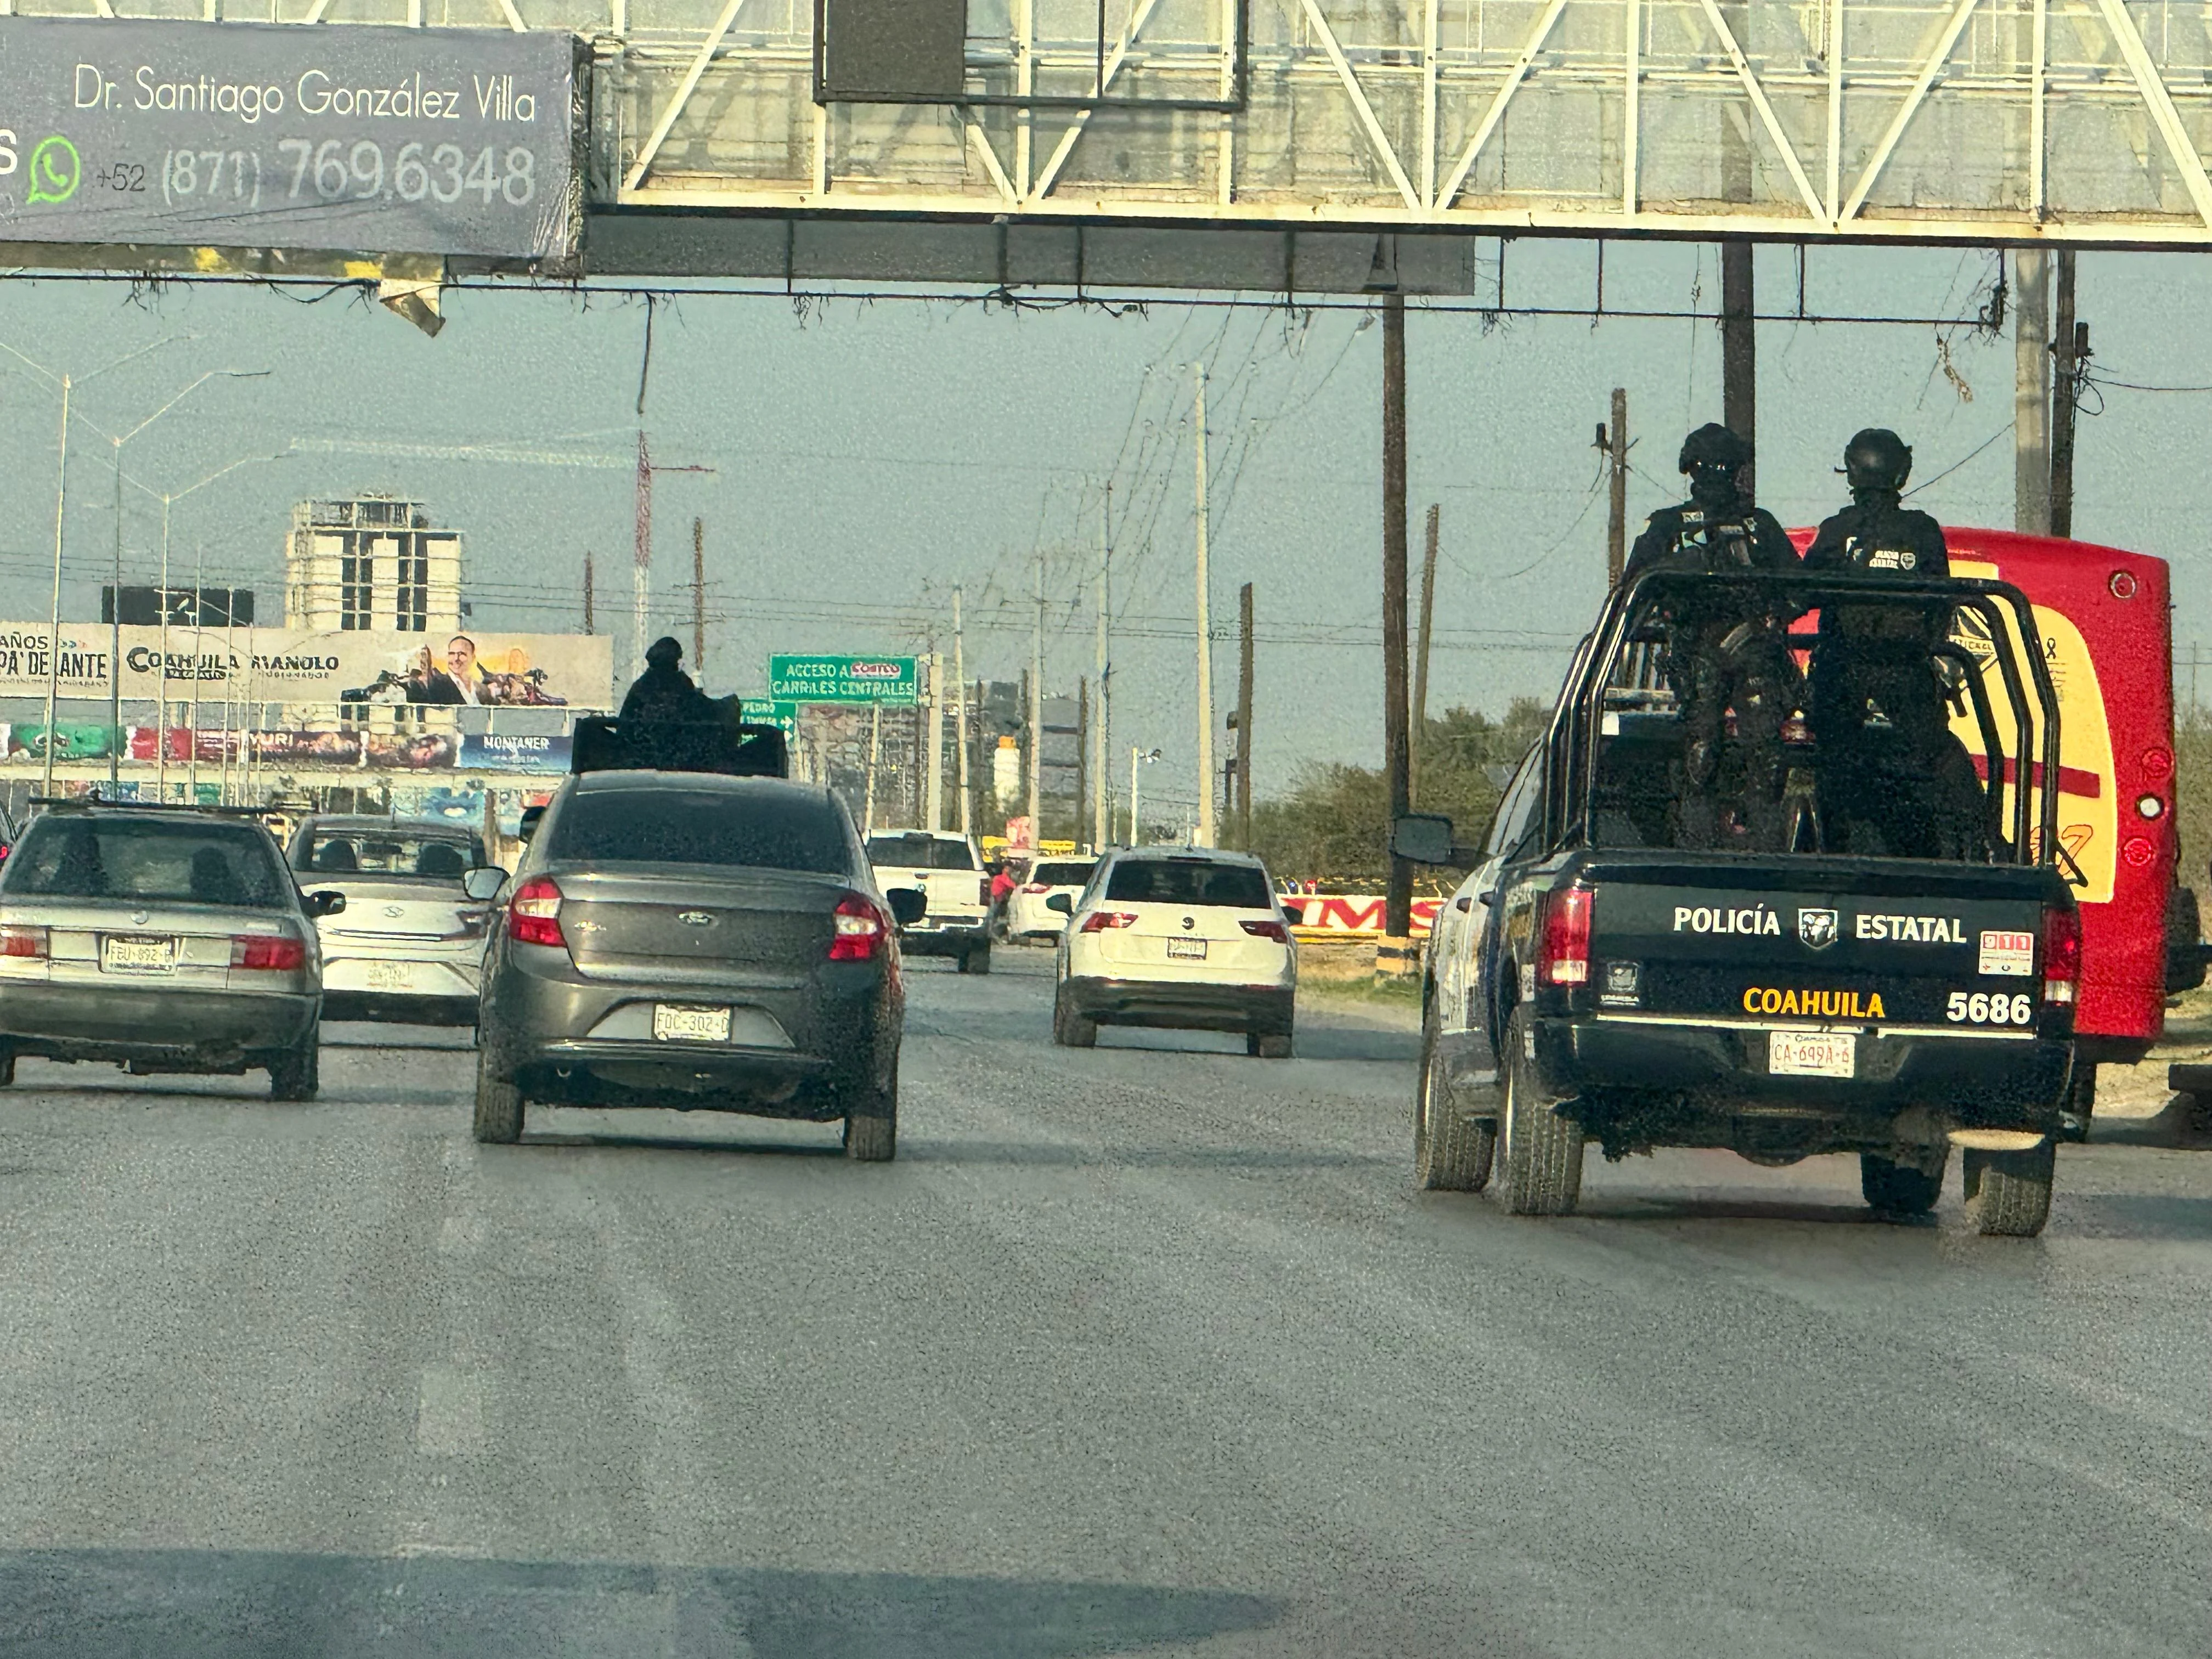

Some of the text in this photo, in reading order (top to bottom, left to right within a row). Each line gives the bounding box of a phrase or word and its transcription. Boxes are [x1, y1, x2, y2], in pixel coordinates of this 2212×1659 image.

[75, 63, 536, 124] Dr. Santiago González Villa
[97, 138, 537, 207] +52 (871) 769.6348
[28, 651, 107, 679] DEANTE
[786, 664, 836, 678] ACCESO
[839, 665, 849, 678] A
[772, 680, 913, 696] CARRILES CENTRALES
[484, 736, 550, 750] MONTANER
[1674, 903, 1967, 943] POLICÍA ESTATAL
[1983, 934, 2030, 950] 911
[1743, 988, 1885, 1018] COAHUILA
[1947, 992, 2031, 1024] 5686
